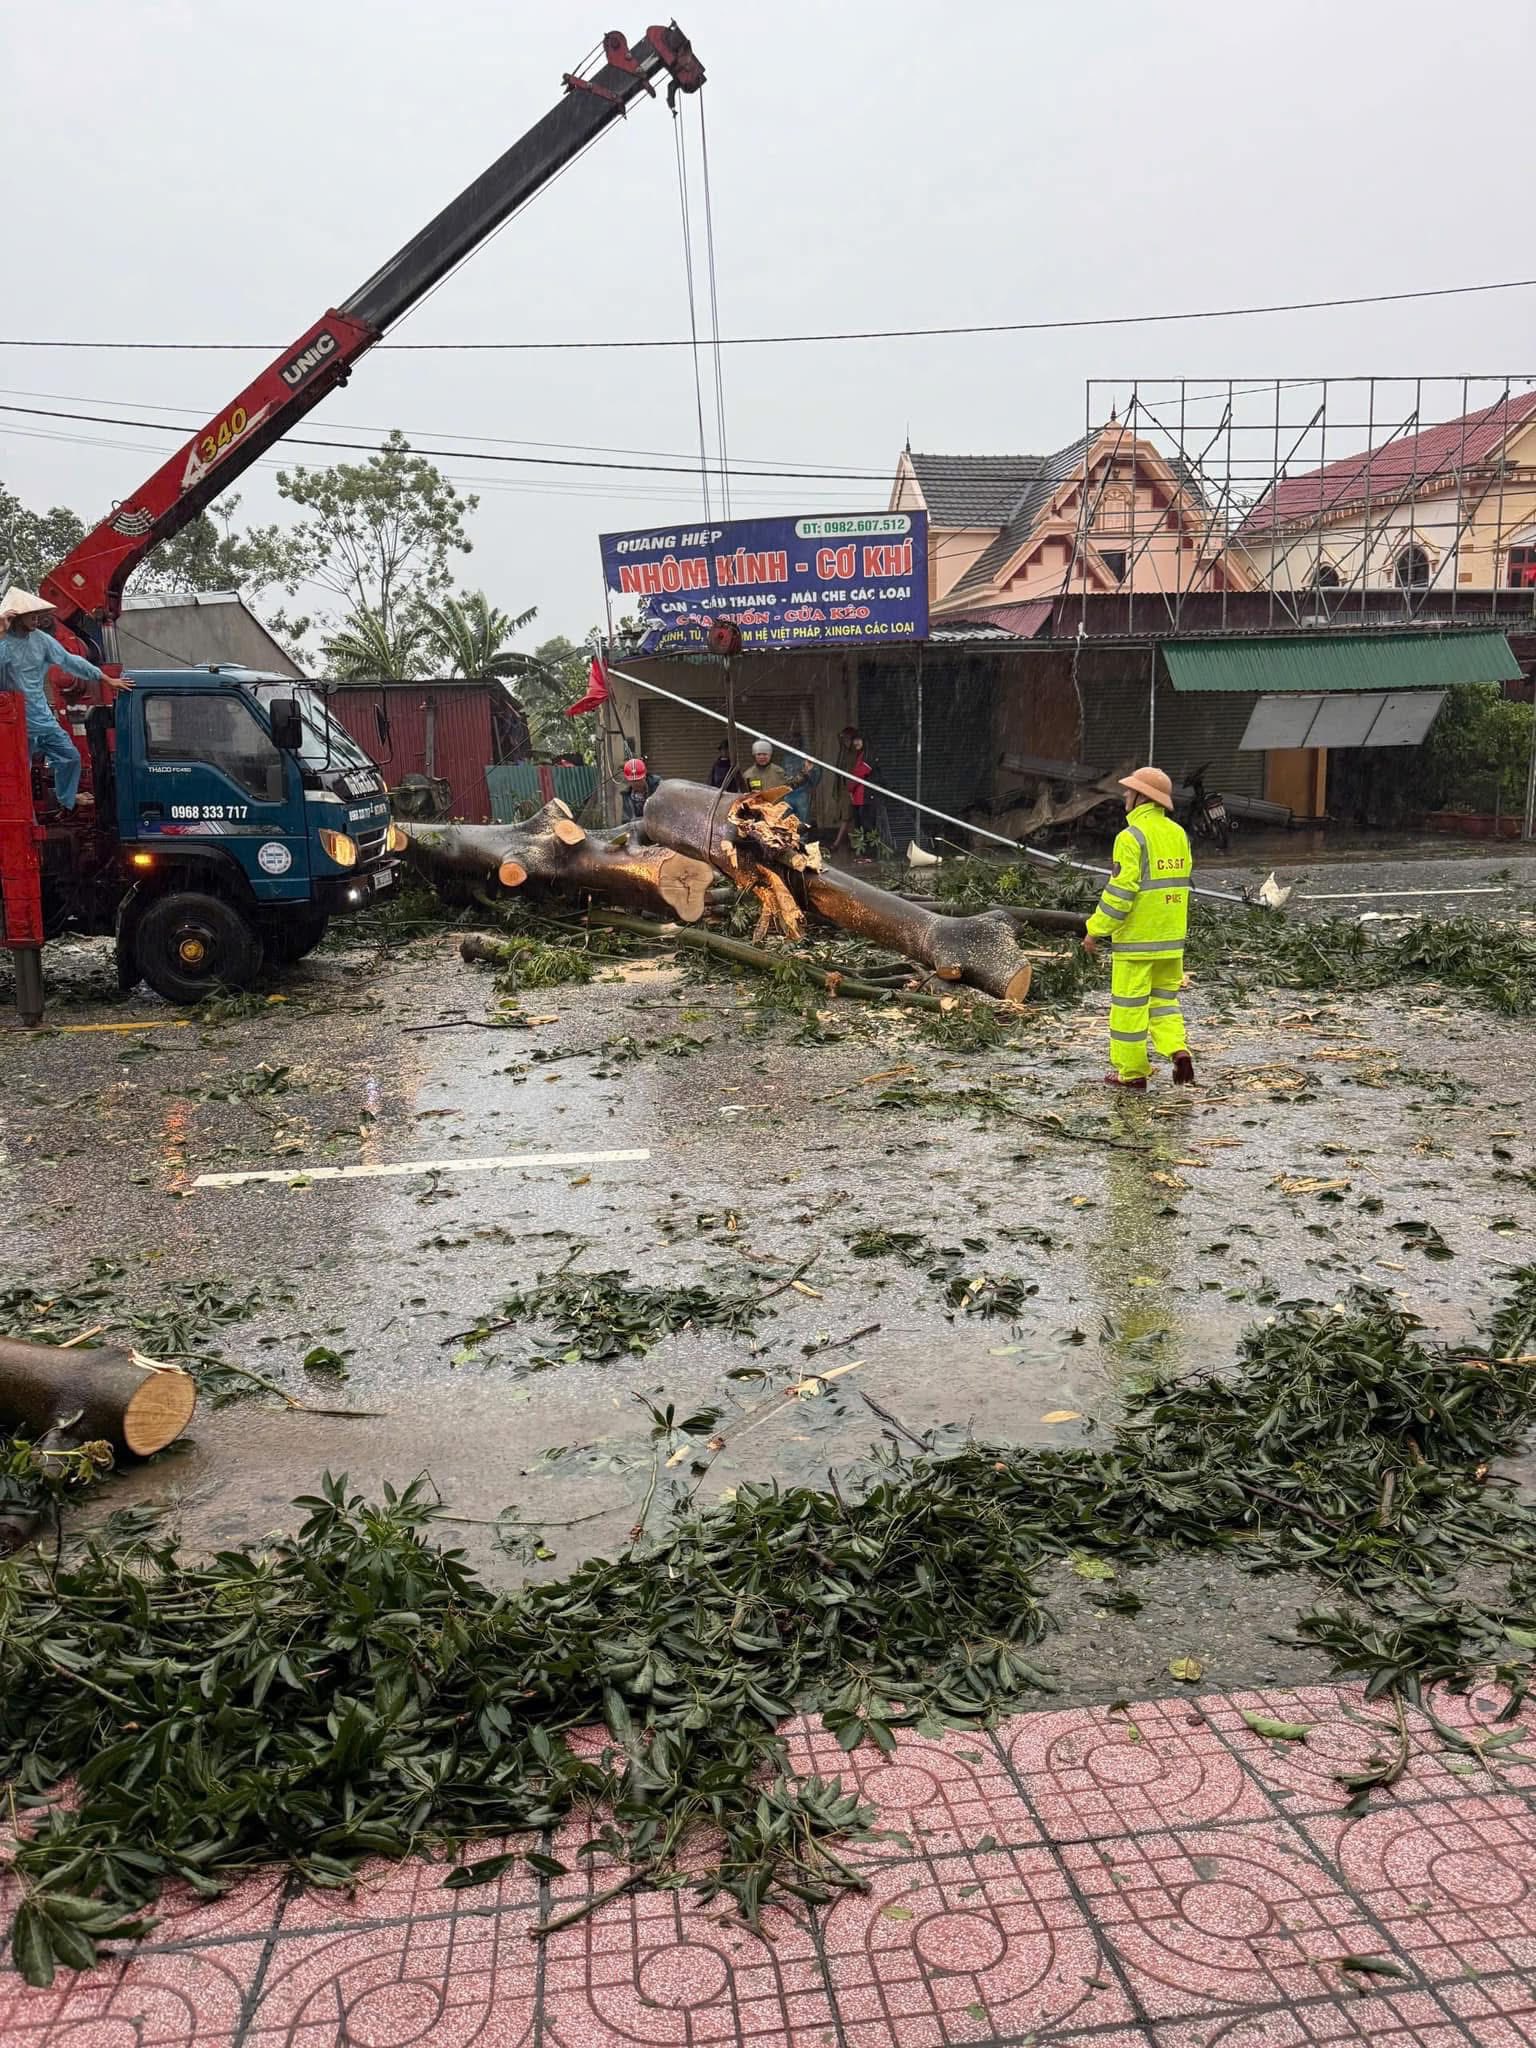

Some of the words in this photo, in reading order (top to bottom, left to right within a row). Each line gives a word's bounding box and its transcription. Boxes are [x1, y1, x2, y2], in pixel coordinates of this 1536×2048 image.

[281, 334, 337, 386] UNIC
[802, 522, 821, 535] ĐT:
[824, 518, 905, 533] 0982.607.512
[616, 535, 676, 554] QUANG
[681, 529, 723, 548] HIỆP
[619, 554, 710, 596] NHÔM
[715, 546, 788, 586] KÍNH
[795, 562, 809, 572] -
[816, 543, 857, 580] CƠ
[863, 537, 913, 578] KHÍ
[729, 594, 777, 607] THANG
[791, 590, 817, 604] MÁI
[821, 590, 846, 602] CHE
[850, 587, 875, 600] CÁC
[879, 587, 911, 601] LOẠI
[784, 605, 826, 622] CỬA
[755, 627, 769, 645] HỆ
[770, 626, 790, 641] VIỆT
[793, 624, 823, 639] PHÁP,
[824, 625, 862, 637] XINGFA
[864, 622, 889, 635] CÁC
[891, 622, 915, 635] LOẠI
[171, 805, 200, 819] 0968
[202, 805, 224, 819] 333
[226, 805, 248, 819] 717
